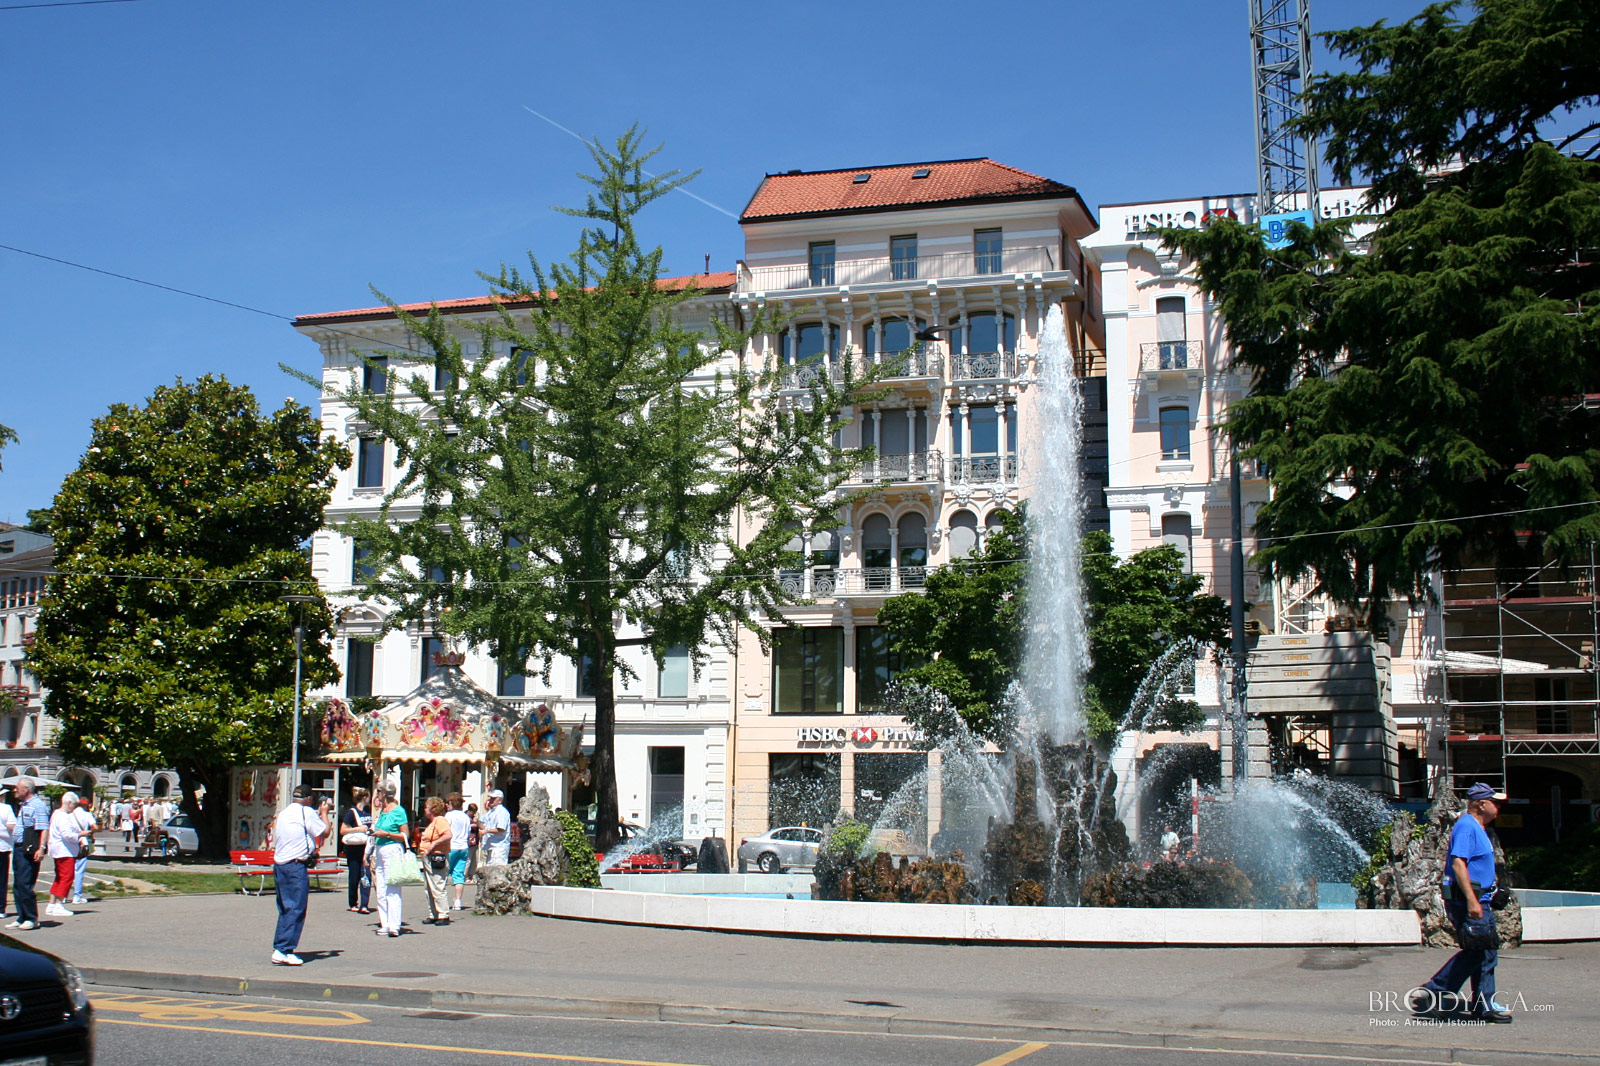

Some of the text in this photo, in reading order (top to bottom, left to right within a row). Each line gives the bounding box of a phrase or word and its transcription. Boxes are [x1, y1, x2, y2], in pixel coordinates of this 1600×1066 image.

[1124, 210, 1204, 234] HSBC
[798, 726, 927, 742] HSBC Priva
